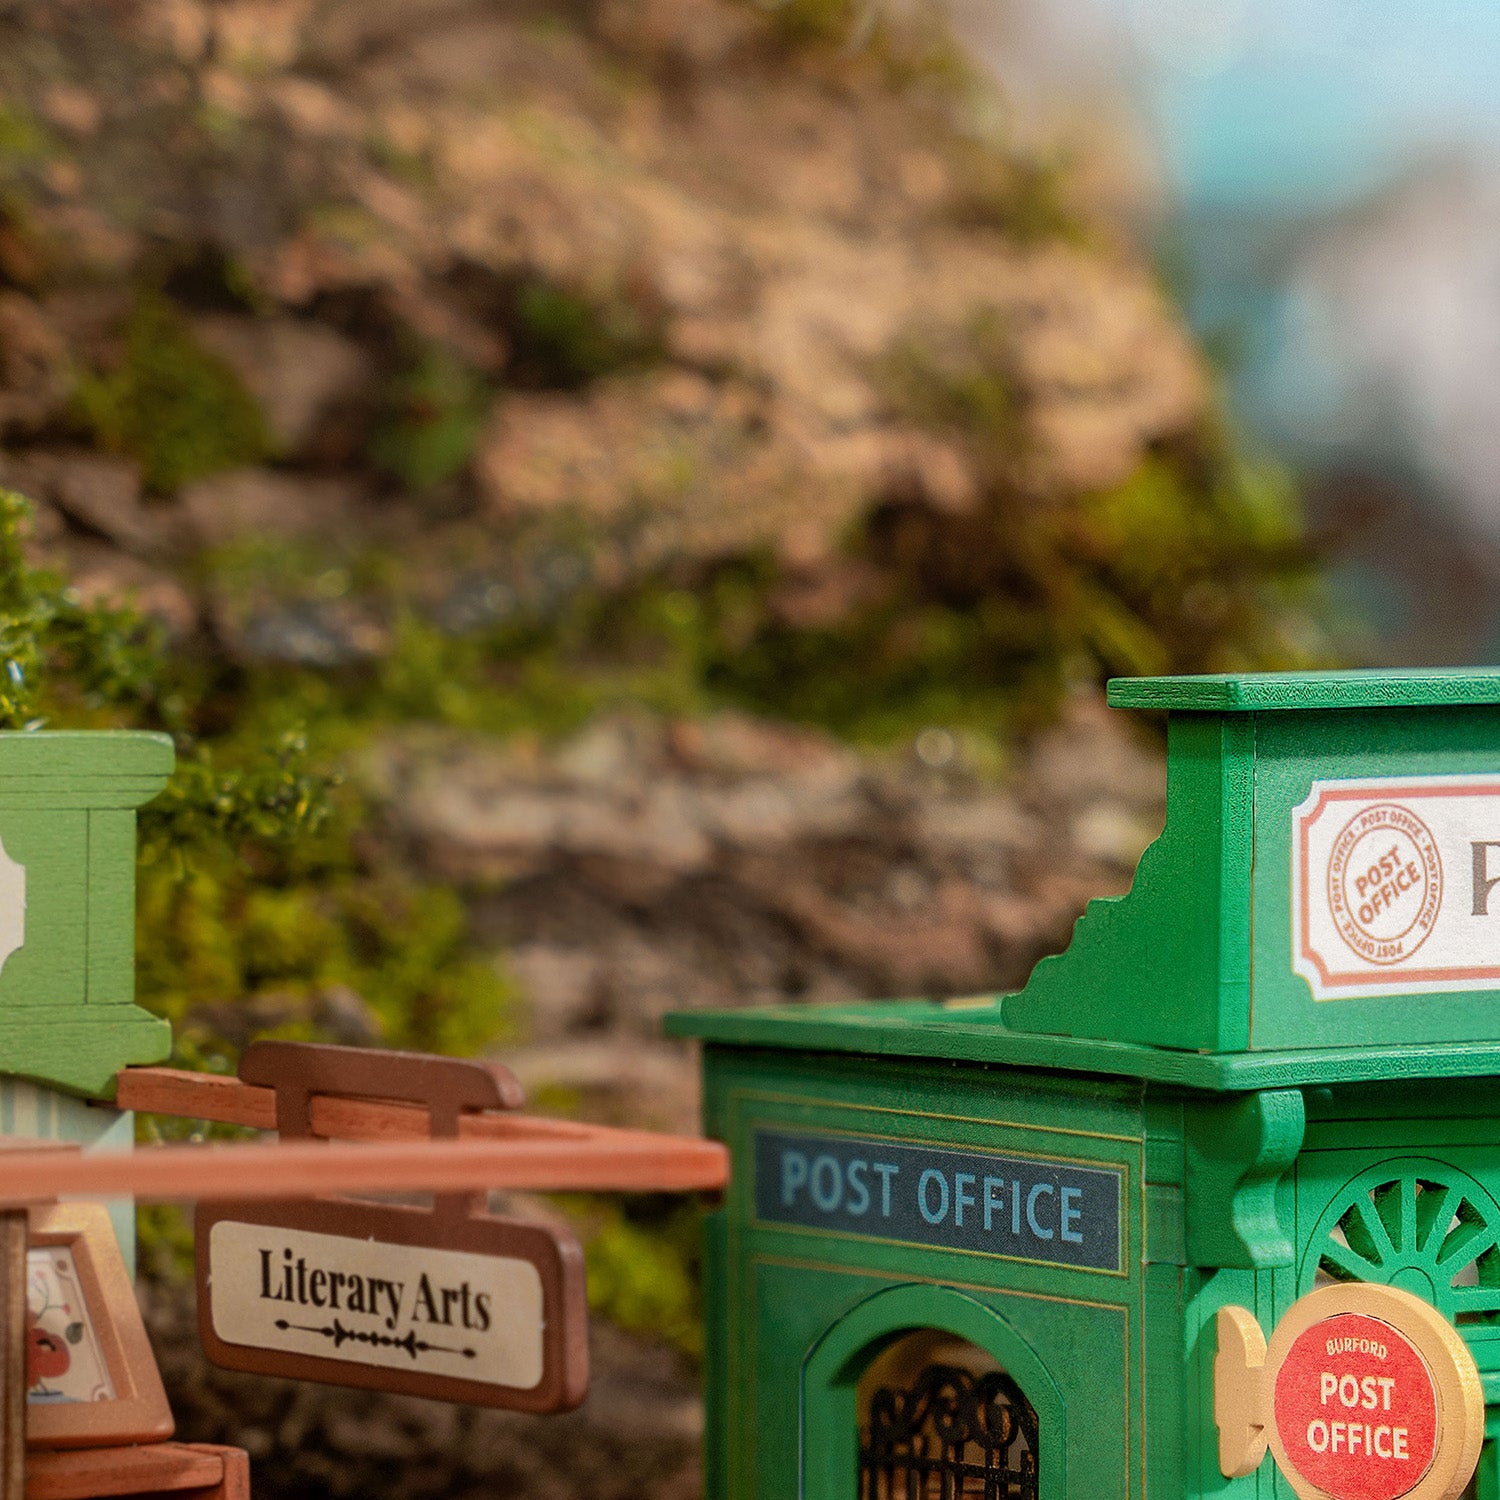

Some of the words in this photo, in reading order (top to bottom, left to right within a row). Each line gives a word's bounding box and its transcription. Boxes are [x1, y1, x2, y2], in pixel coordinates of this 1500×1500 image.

[1355, 844, 1402, 898] POST
[1358, 861, 1421, 925] OFFICE
[780, 1151, 899, 1217] POST
[917, 1168, 1083, 1243] OFFICE
[257, 1247, 404, 1330] Literary
[411, 1272, 493, 1332] Arts
[1325, 1336, 1389, 1360] BURFORD
[1319, 1371, 1396, 1411] POST
[1306, 1418, 1410, 1460] OFFICE
